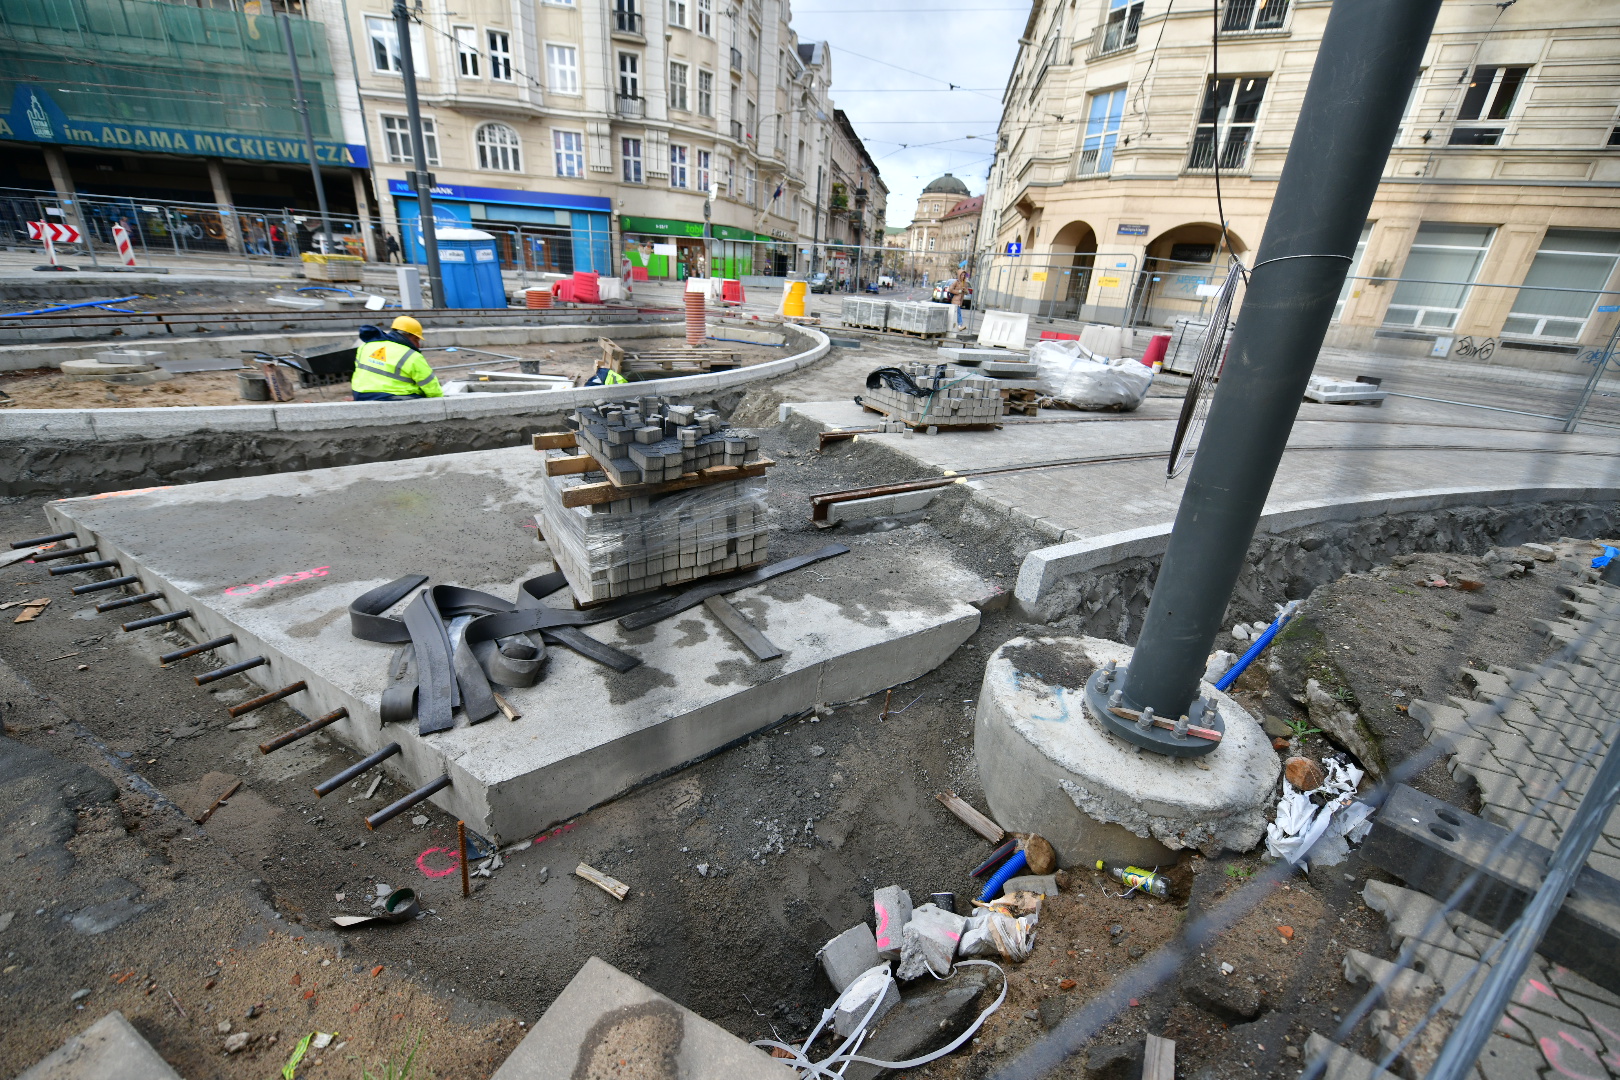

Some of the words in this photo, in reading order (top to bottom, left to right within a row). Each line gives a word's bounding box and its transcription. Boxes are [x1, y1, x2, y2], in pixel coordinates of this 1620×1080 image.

[63, 124, 99, 142] im.
[102, 126, 189, 151] ADAMA
[194, 134, 355, 164] MICKIEWICZA
